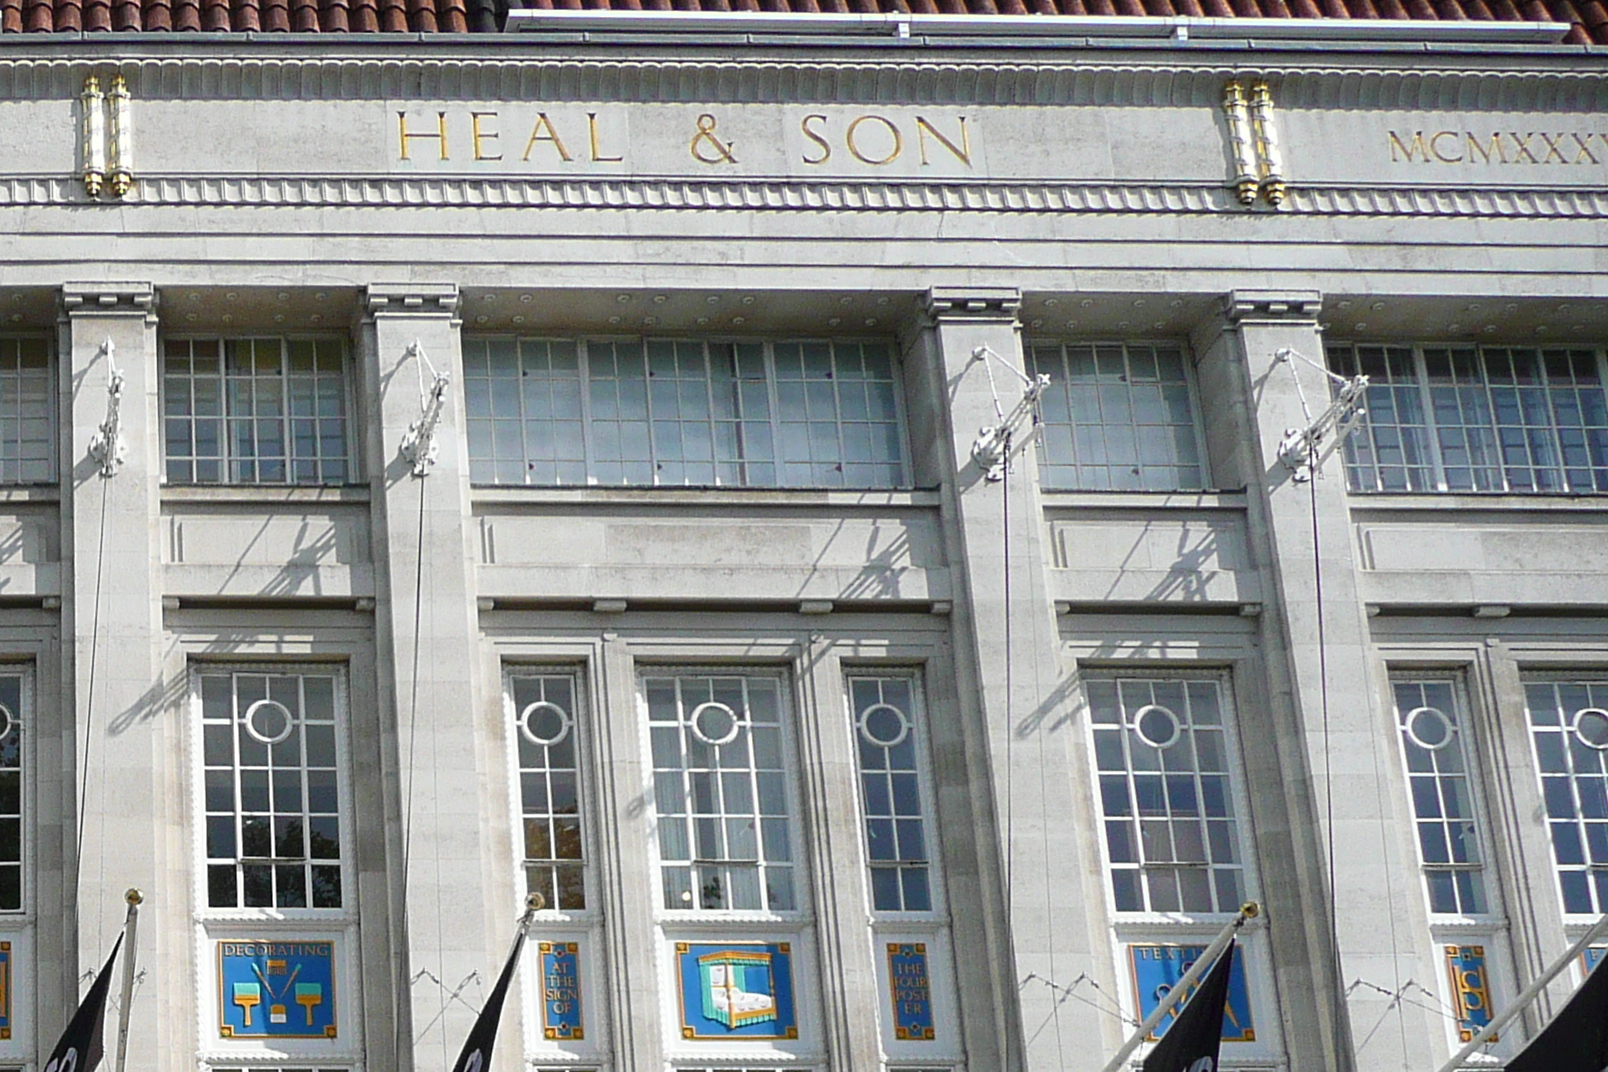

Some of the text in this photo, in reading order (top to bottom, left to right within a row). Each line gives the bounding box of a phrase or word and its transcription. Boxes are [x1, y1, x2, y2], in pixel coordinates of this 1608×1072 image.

[396, 111, 973, 168] HEAL & SON
[224, 943, 329, 957] DECORATING
[552, 962, 570, 974] AT
[897, 963, 923, 975] THE
[548, 975, 575, 988] THE
[546, 988, 578, 1001] SIGN
[552, 1001, 572, 1014] OF
